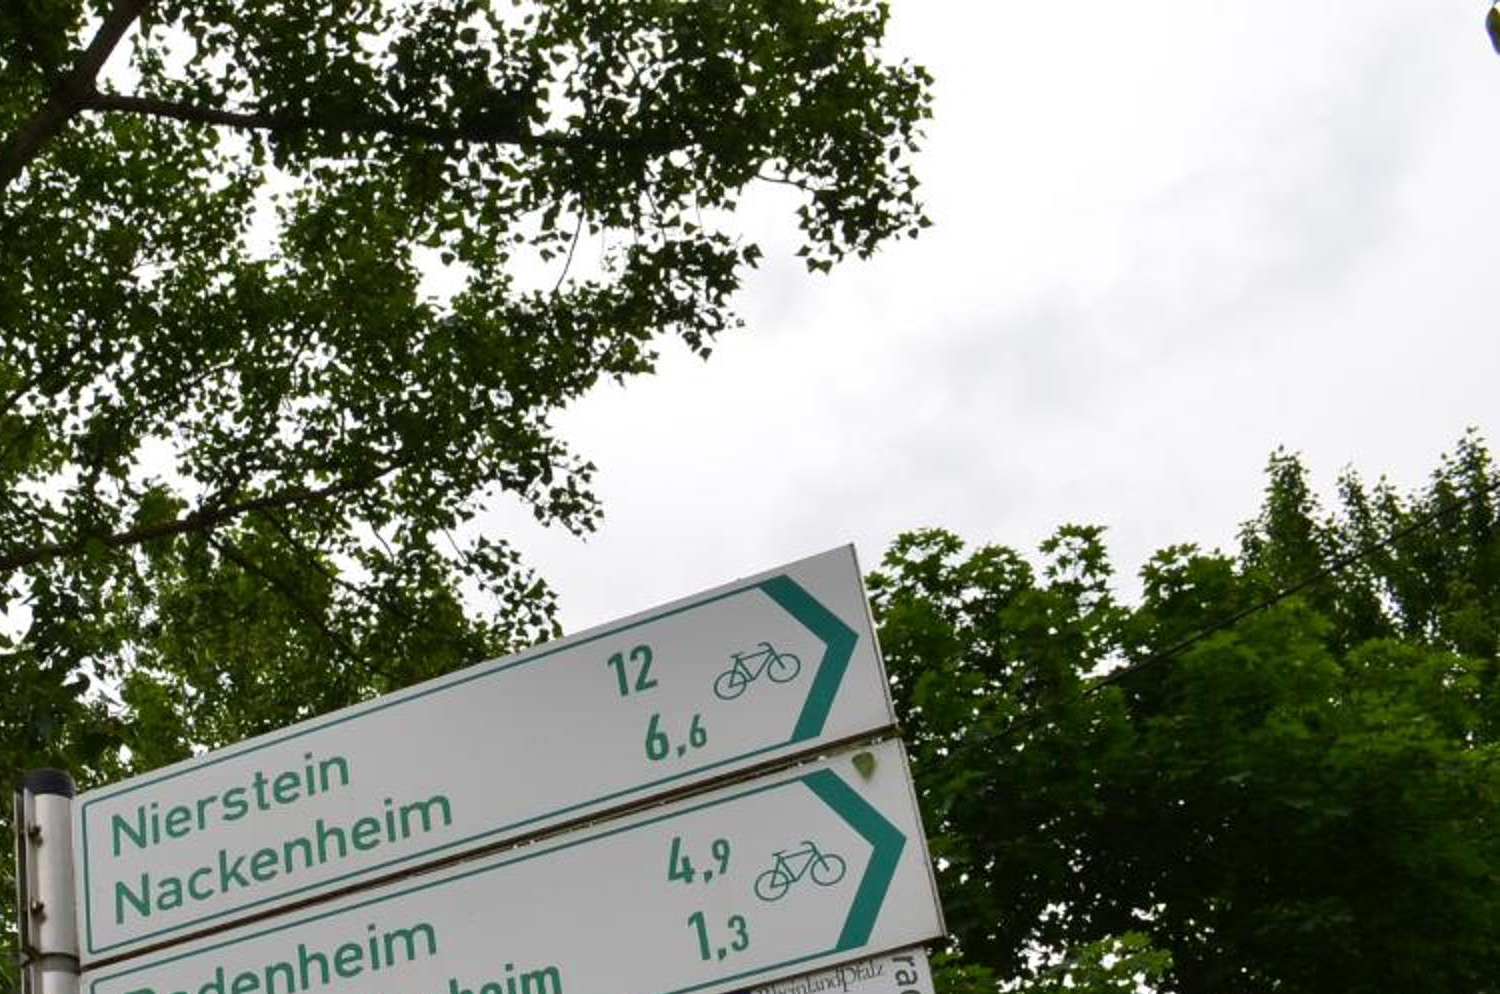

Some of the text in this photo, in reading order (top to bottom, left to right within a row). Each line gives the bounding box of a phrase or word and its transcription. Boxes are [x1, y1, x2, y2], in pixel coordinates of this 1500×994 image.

[111, 645, 658, 856] Nierstein 12
[115, 713, 708, 923] Nackenheim 6,6
[668, 837, 731, 884] 4,9
[688, 911, 750, 961] 1,3
